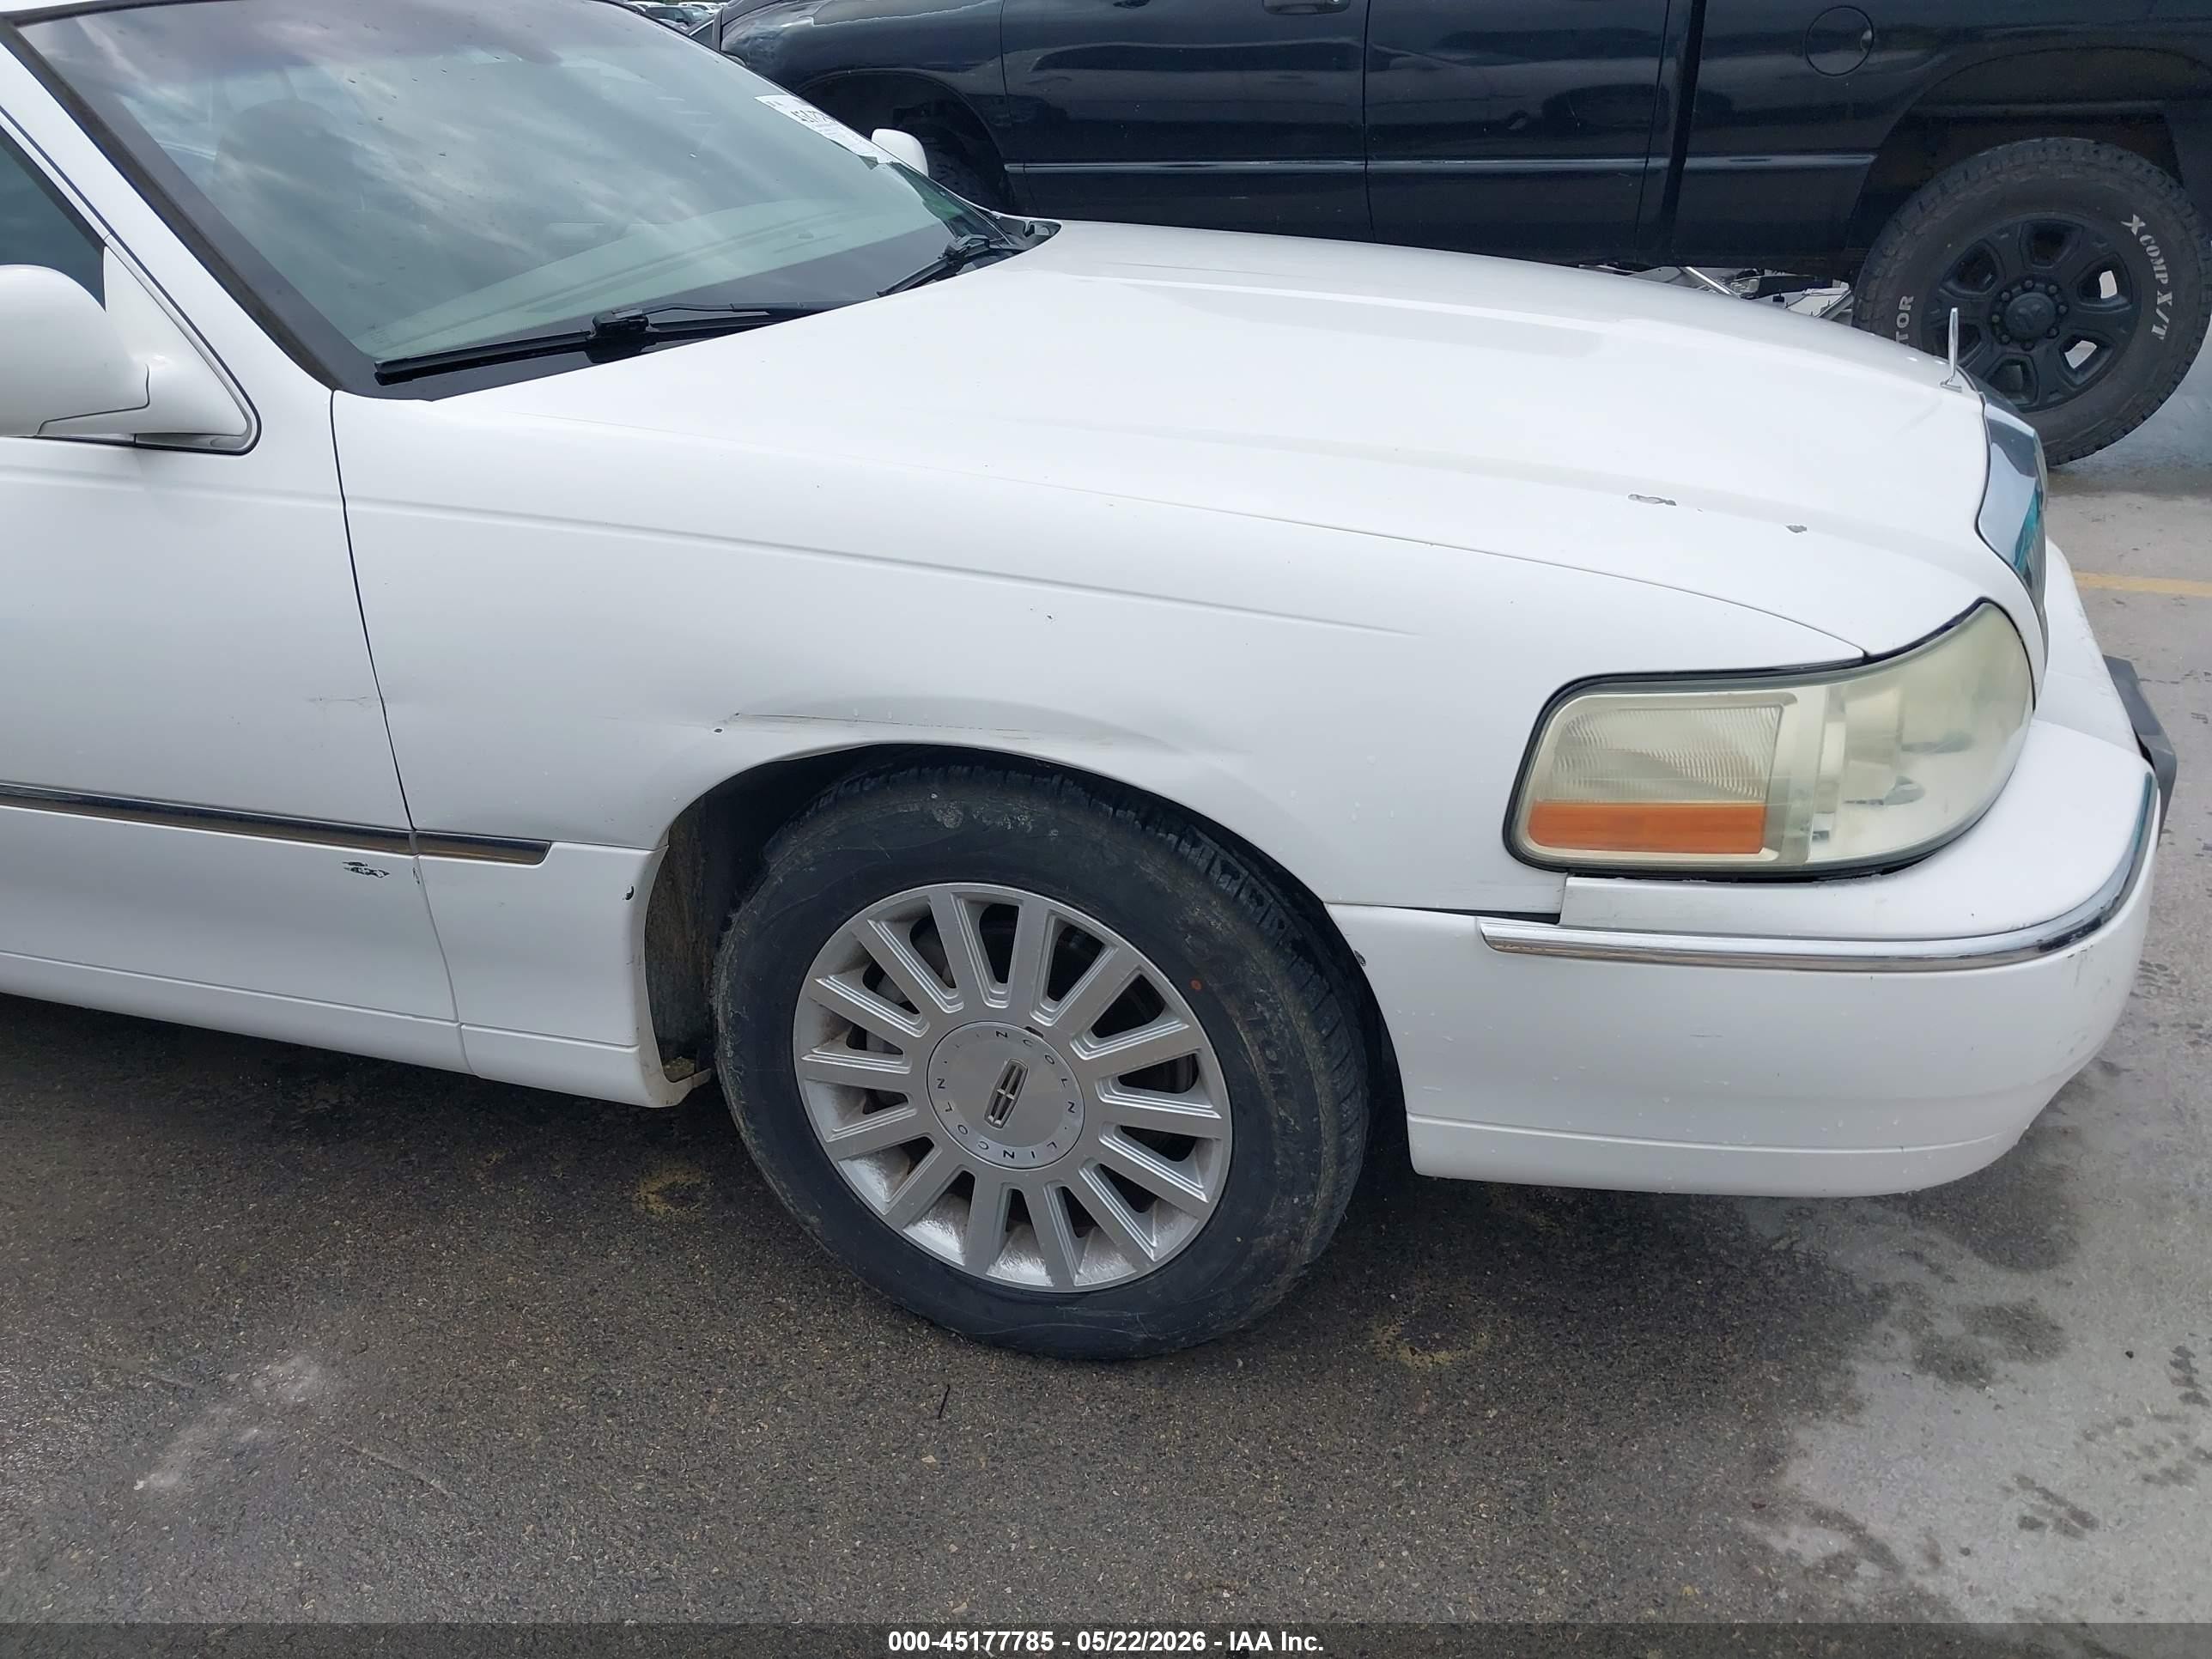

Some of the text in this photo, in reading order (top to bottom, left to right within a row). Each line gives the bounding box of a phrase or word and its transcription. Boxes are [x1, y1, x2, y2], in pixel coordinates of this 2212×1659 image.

[2151, 290, 2172, 340] X/T
[953, 1030, 1076, 1115] NCOLN
[936, 1077, 1058, 1159] LINCOLN
